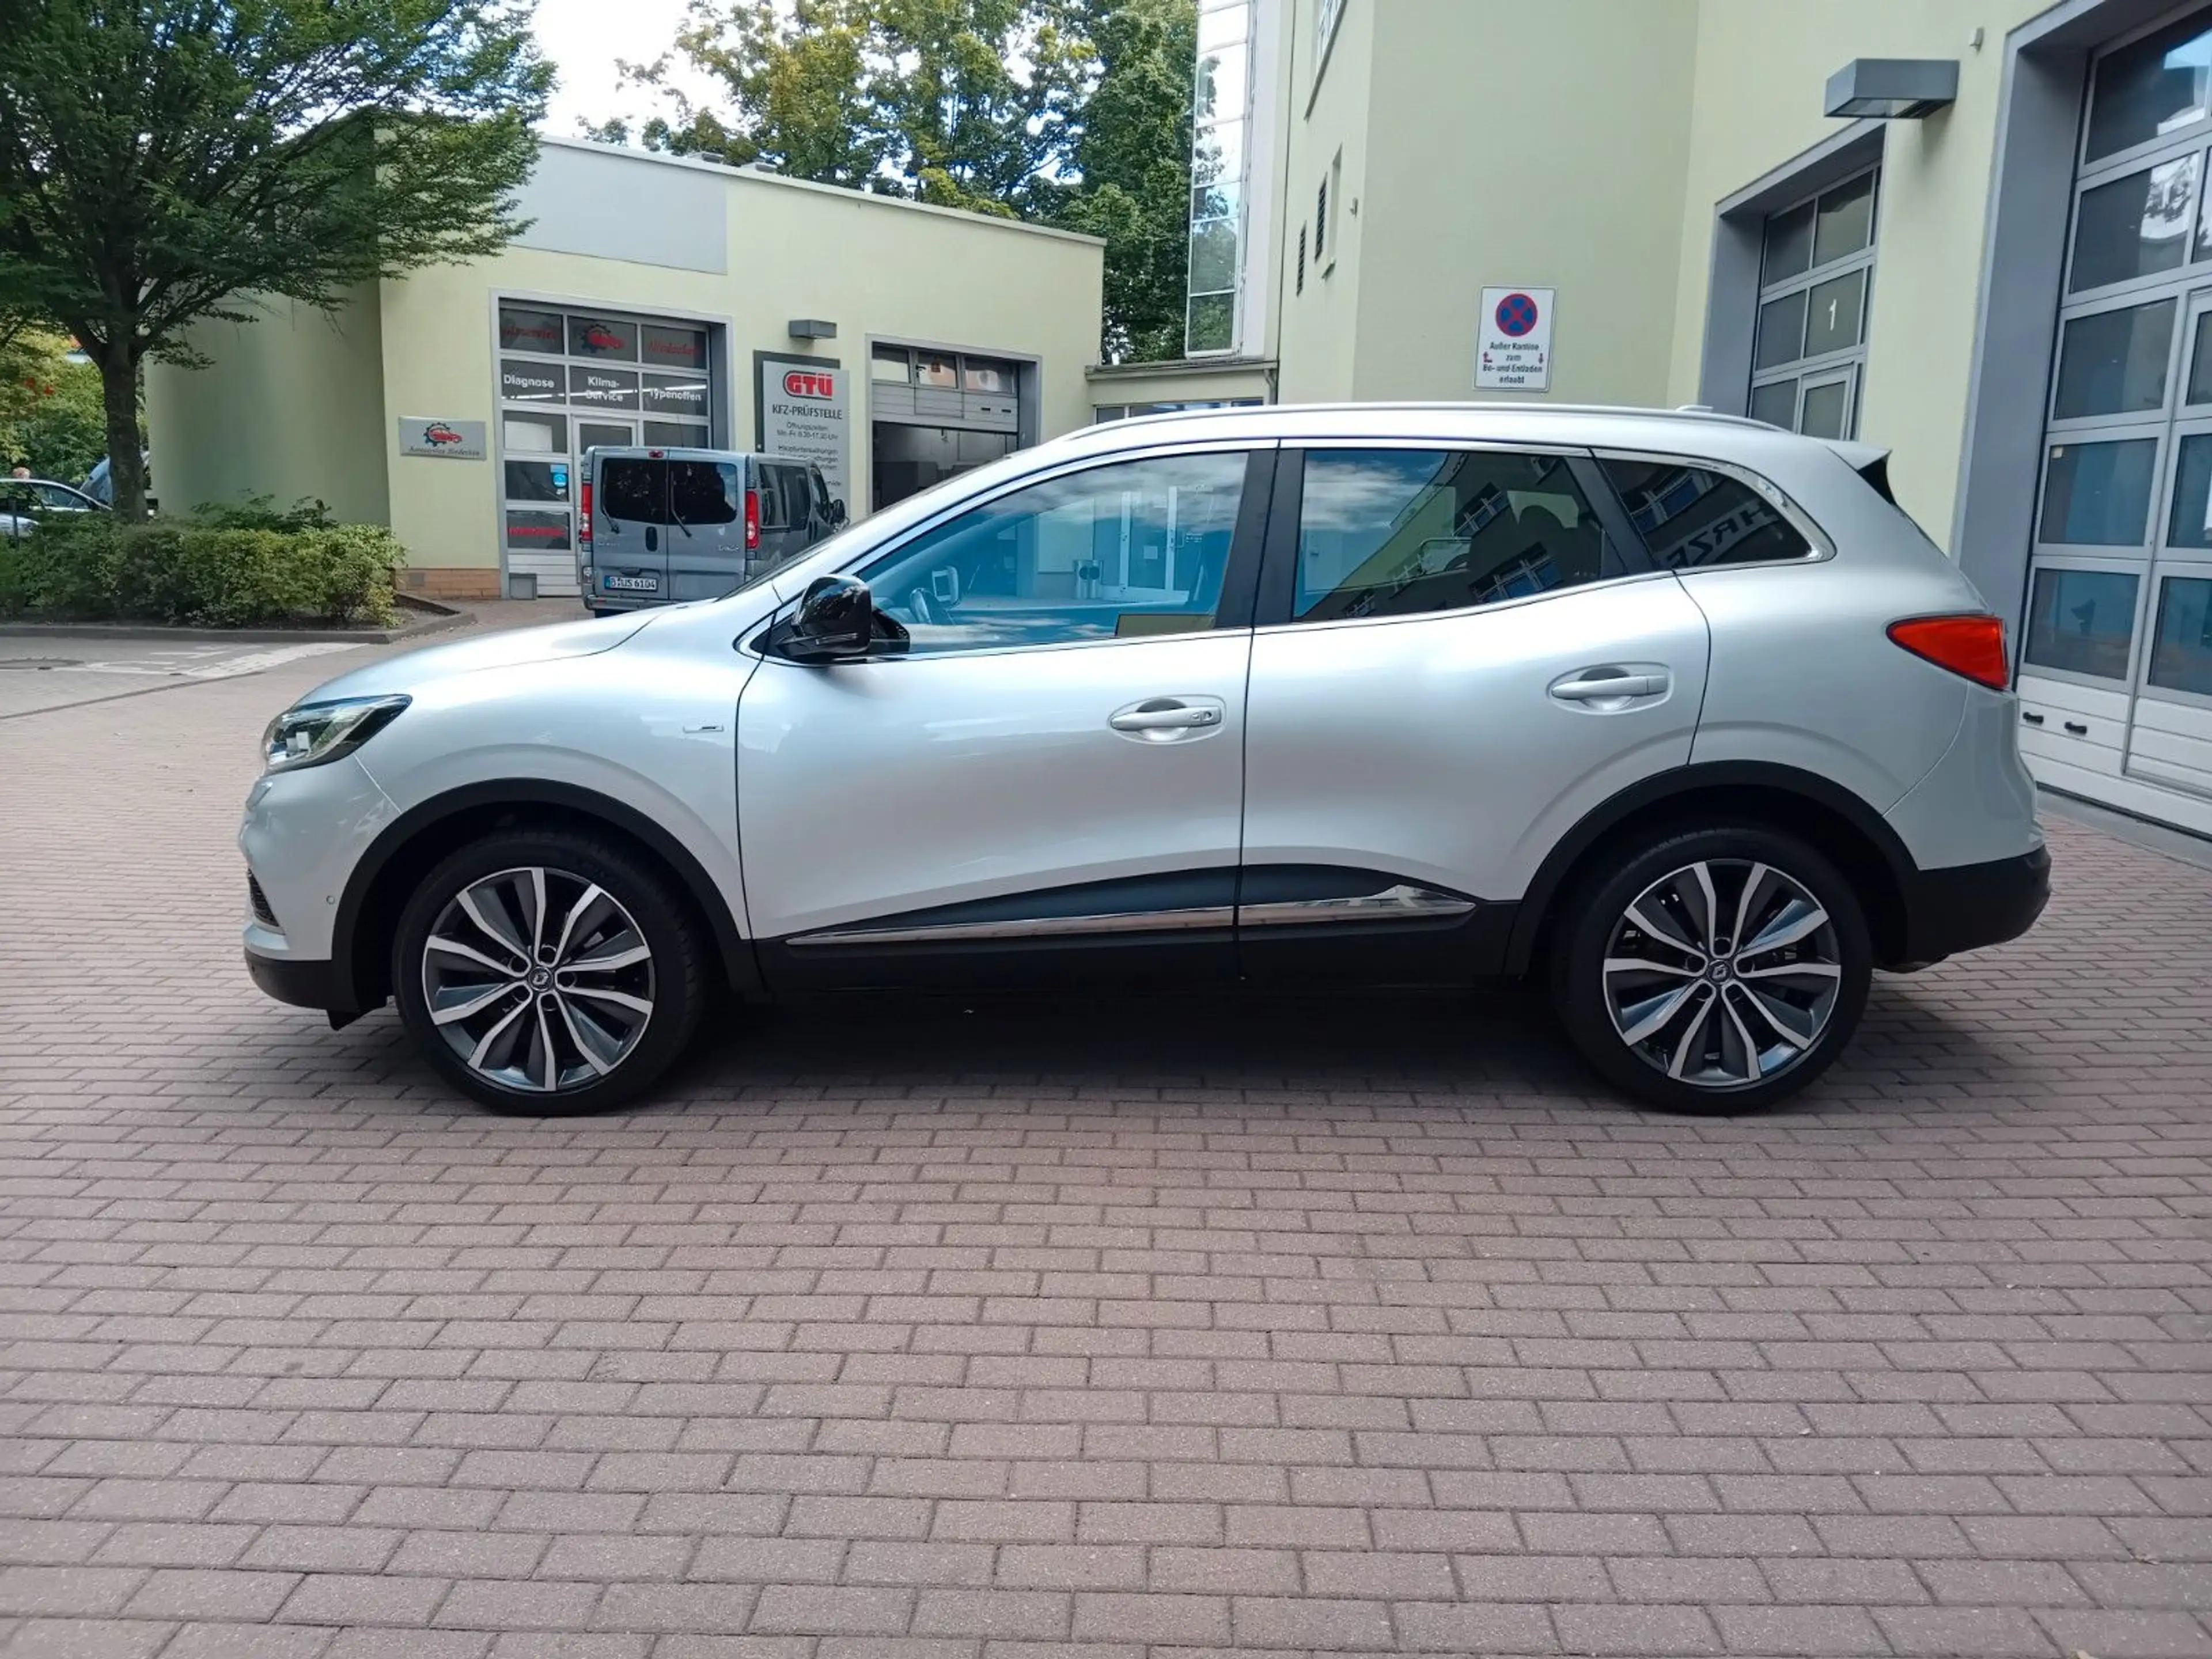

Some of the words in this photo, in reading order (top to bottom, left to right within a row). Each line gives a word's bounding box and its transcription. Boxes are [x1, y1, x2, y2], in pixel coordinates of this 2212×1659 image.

[1829, 299, 1836, 331] 1
[1489, 342, 1511, 351] Außer
[1512, 364, 1543, 373] Entladen
[503, 374, 555, 388] Diagnose
[588, 376, 620, 388] Klima-
[786, 373, 833, 397] GTÜ
[1499, 375, 1525, 384] erlaubt
[586, 389, 623, 402] Service
[772, 404, 843, 419] KFZ-PRÜFSTELLE
